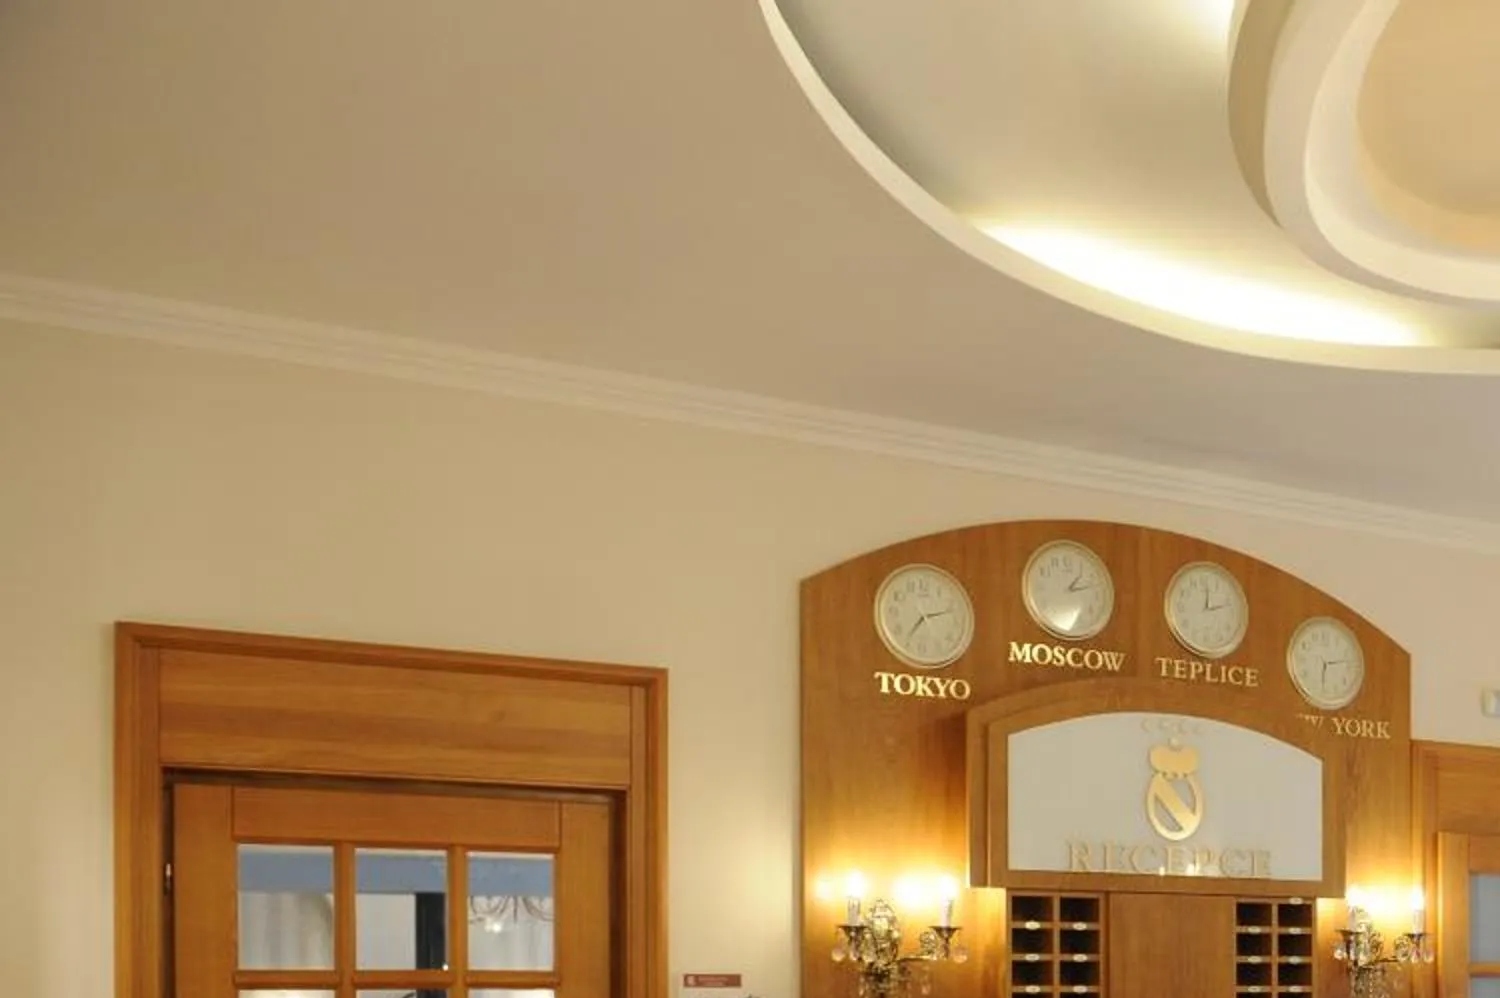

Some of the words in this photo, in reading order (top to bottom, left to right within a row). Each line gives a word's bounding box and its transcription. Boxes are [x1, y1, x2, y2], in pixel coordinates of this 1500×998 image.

[1008, 641, 1126, 672] MOSCOW
[1155, 656, 1260, 687] TEPLICE
[874, 671, 971, 700] TOKYO
[1331, 717, 1391, 739] YORK
[1065, 840, 1272, 878] RECEPCE
